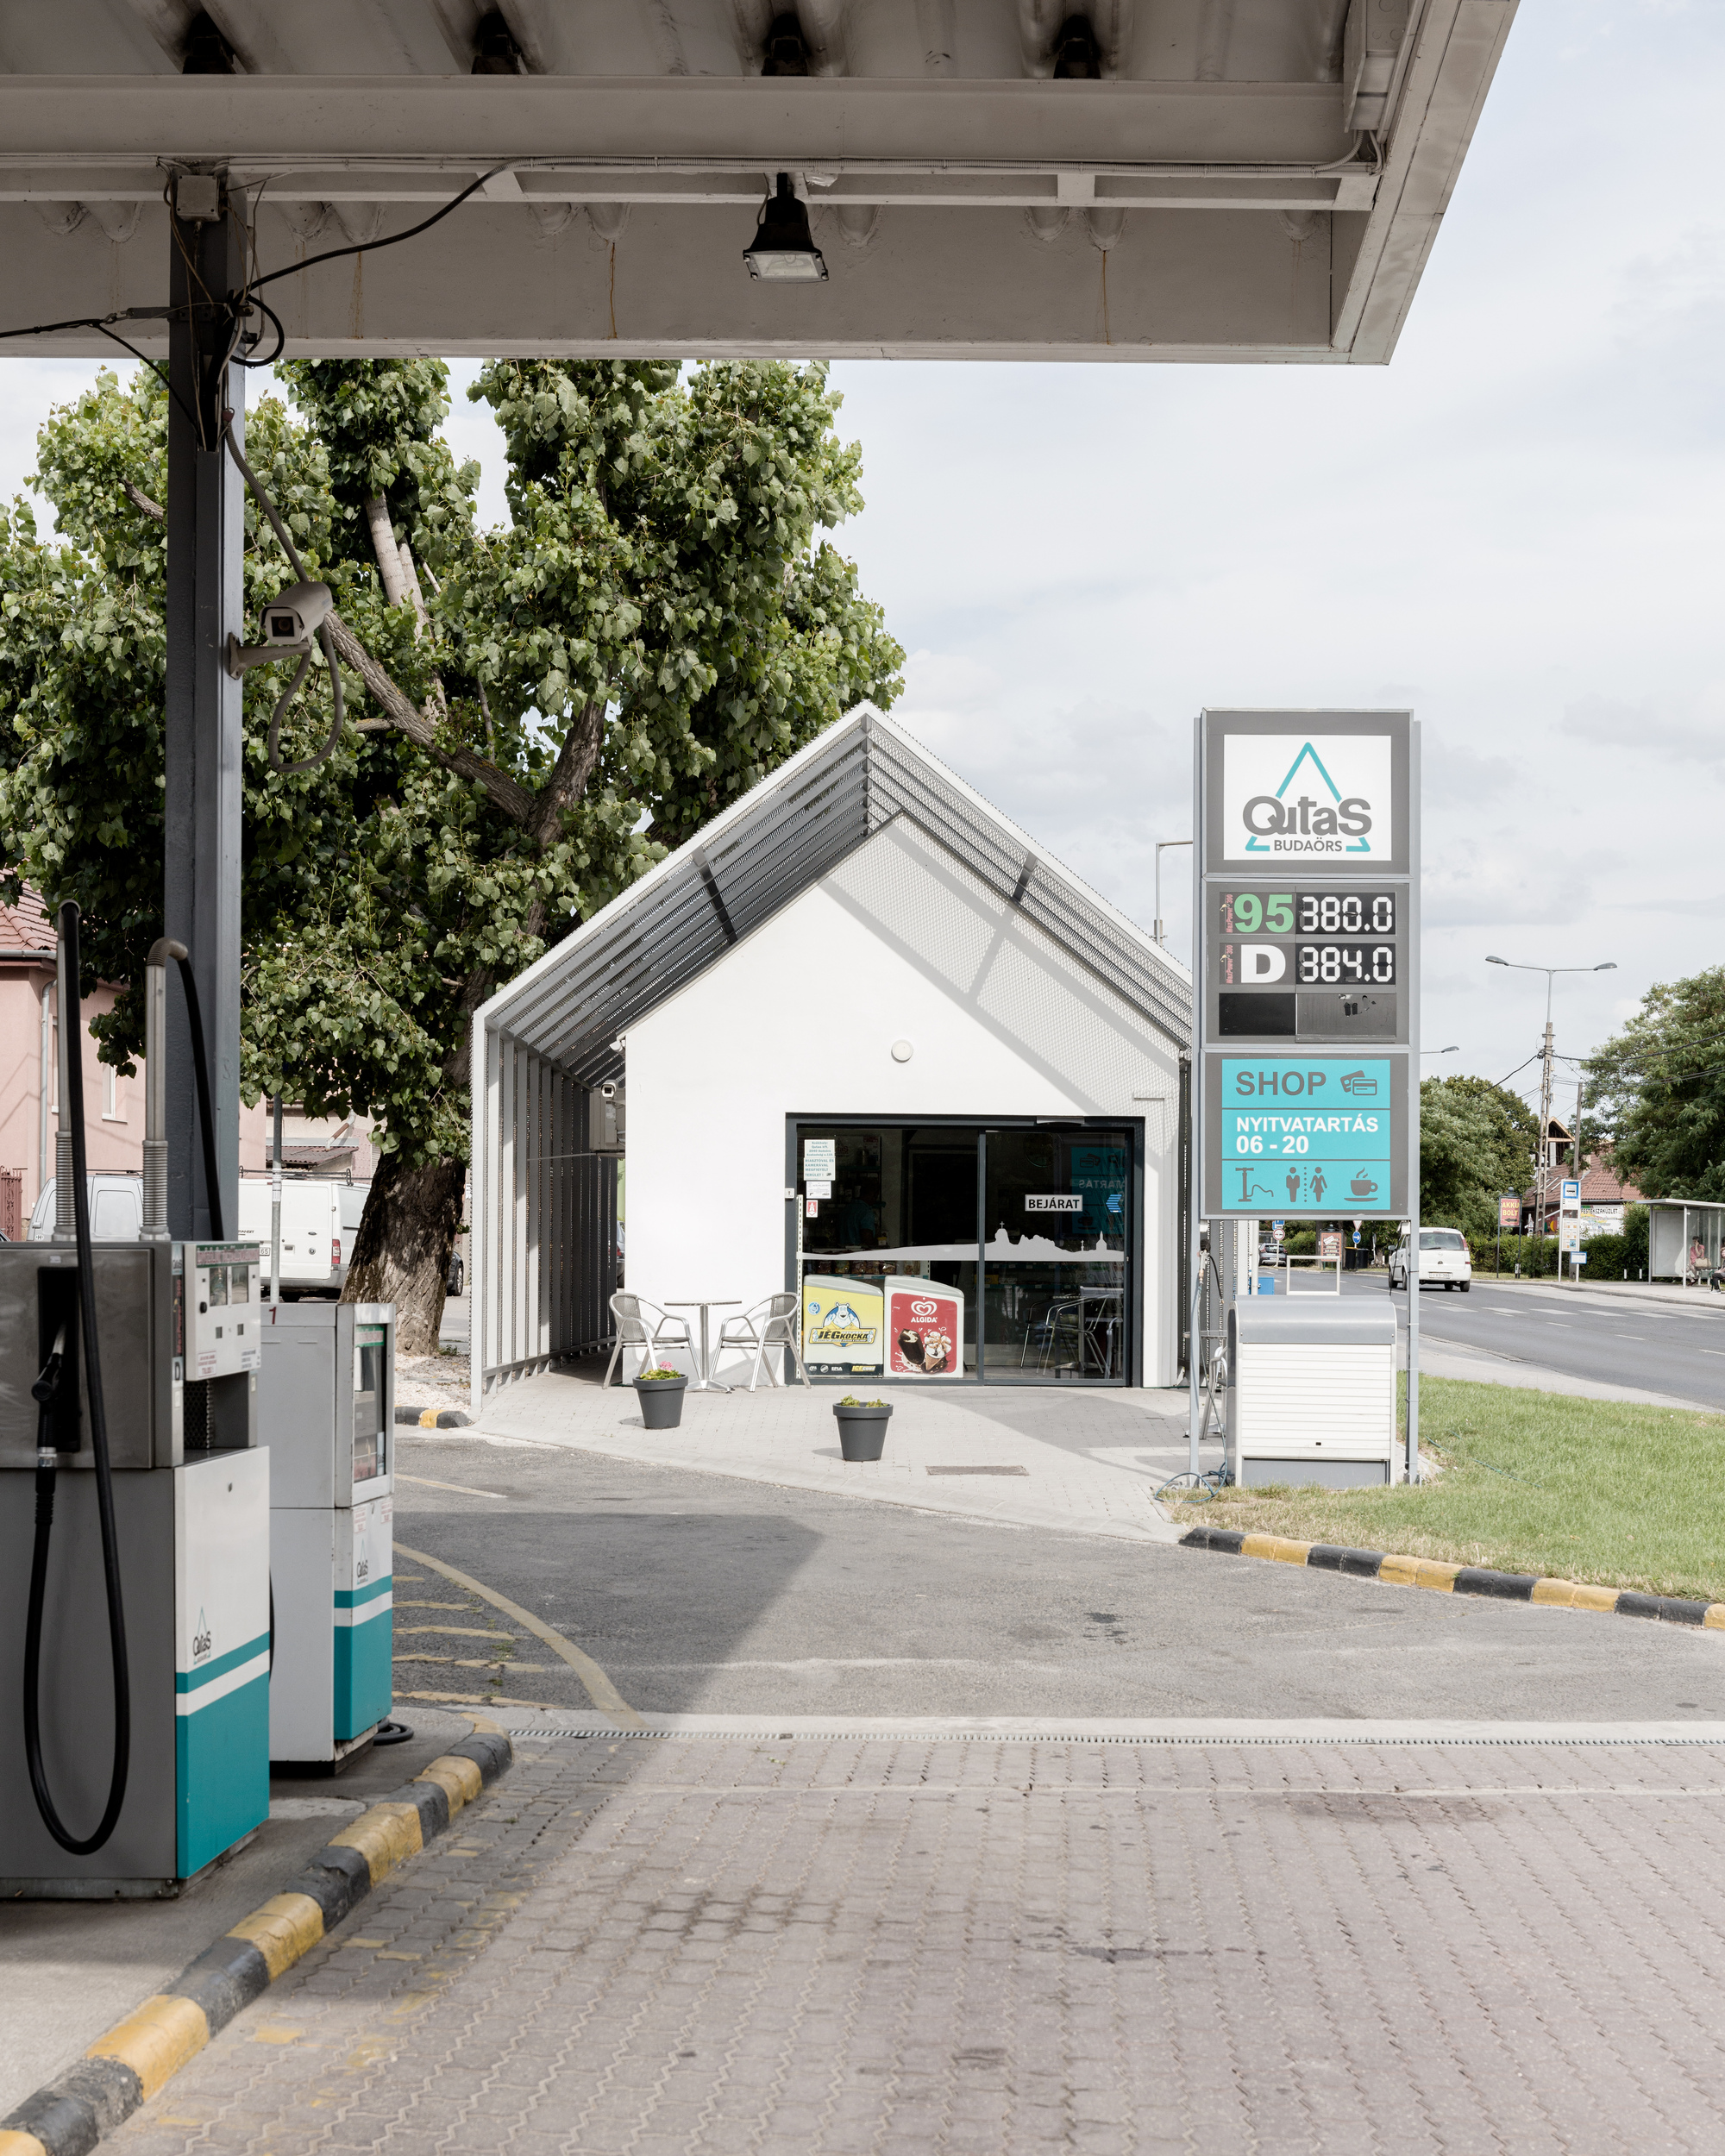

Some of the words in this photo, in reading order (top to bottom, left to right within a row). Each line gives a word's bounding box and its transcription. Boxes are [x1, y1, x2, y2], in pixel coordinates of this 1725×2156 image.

[1274, 837, 1343, 852] BUDAÖRS
[1233, 893, 1294, 933] 95
[1240, 944, 1286, 983] D
[1235, 1071, 1327, 1096] SHOP
[1236, 1113, 1379, 1132] NYITVATARTÁS
[1236, 1135, 1264, 1154] 06
[1282, 1135, 1309, 1154] 20
[1028, 1197, 1080, 1209] BEJÁRAT
[268, 1307, 277, 1325] 1
[174, 1362, 181, 1381] D
